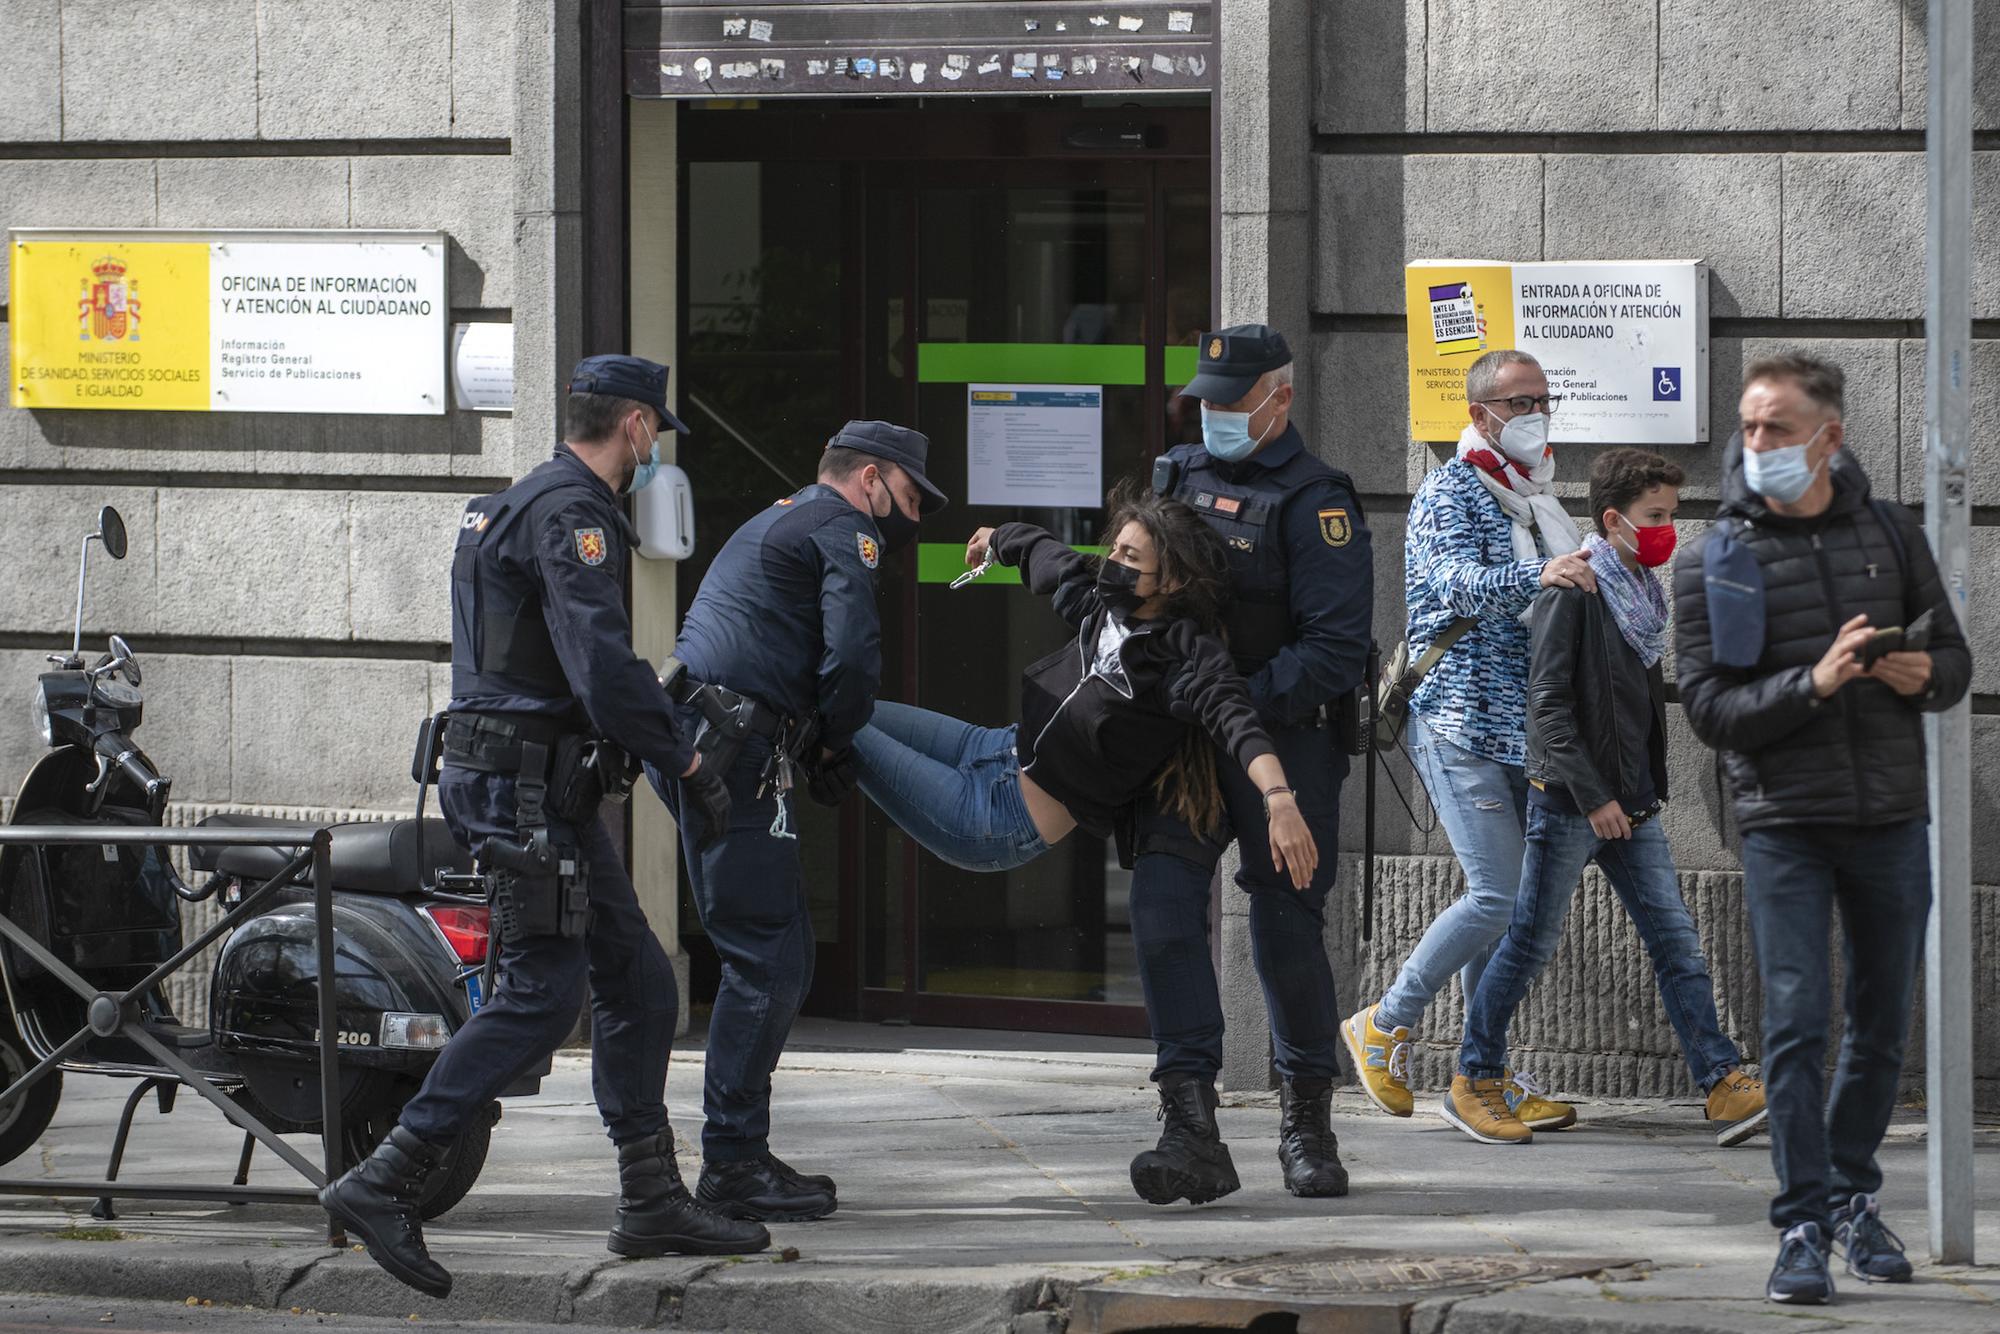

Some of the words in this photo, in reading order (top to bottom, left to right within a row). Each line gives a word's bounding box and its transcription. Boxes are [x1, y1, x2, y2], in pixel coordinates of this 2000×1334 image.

[222, 276, 281, 291] OFICINA
[286, 276, 306, 292] DE
[311, 274, 416, 292] INFORMACIÓN
[1522, 284, 1580, 298] ENTRADA
[1582, 284, 1591, 298] A
[1594, 284, 1642, 298] OFICINA
[1646, 284, 1662, 298] DE
[222, 298, 231, 313] Y
[236, 295, 311, 314] ATENCIÓN
[317, 299, 336, 314] AL
[340, 300, 431, 316] CIUDADANO
[1433, 304, 1448, 314] ANTE
[1448, 304, 1456, 312] LA
[1522, 301, 1606, 318] INFORMACIÓN
[1610, 304, 1618, 318] Y
[1620, 300, 1682, 318] ATENCIÓN
[1434, 320, 1440, 328] EL
[1442, 316, 1476, 327] FEMINISMO
[1436, 328, 1444, 338] ES
[1445, 324, 1476, 336] ESENCIAL
[1524, 325, 1538, 338] AL
[1542, 324, 1614, 338] CIUDADANO
[221, 339, 286, 350] Información
[78, 352, 140, 364] MINISTERIO
[222, 353, 266, 366] Registro
[270, 354, 312, 365] General
[20, 367, 35, 380] DE
[92, 368, 144, 381] SERVICIOS
[148, 369, 200, 382] SOCIALES
[222, 367, 266, 378] Servicio
[269, 368, 282, 378] de
[286, 368, 362, 380] Publicaciones
[1416, 368, 1460, 376] MINISTERIO
[1426, 380, 1464, 389] SERVICIOS
[1562, 380, 1597, 388] General
[76, 384, 82, 397] E
[85, 384, 143, 398] IGUALDAD
[1440, 393, 1446, 401] E
[1570, 392, 1628, 402] Publicaciones
[473, 997, 480, 1008] E
